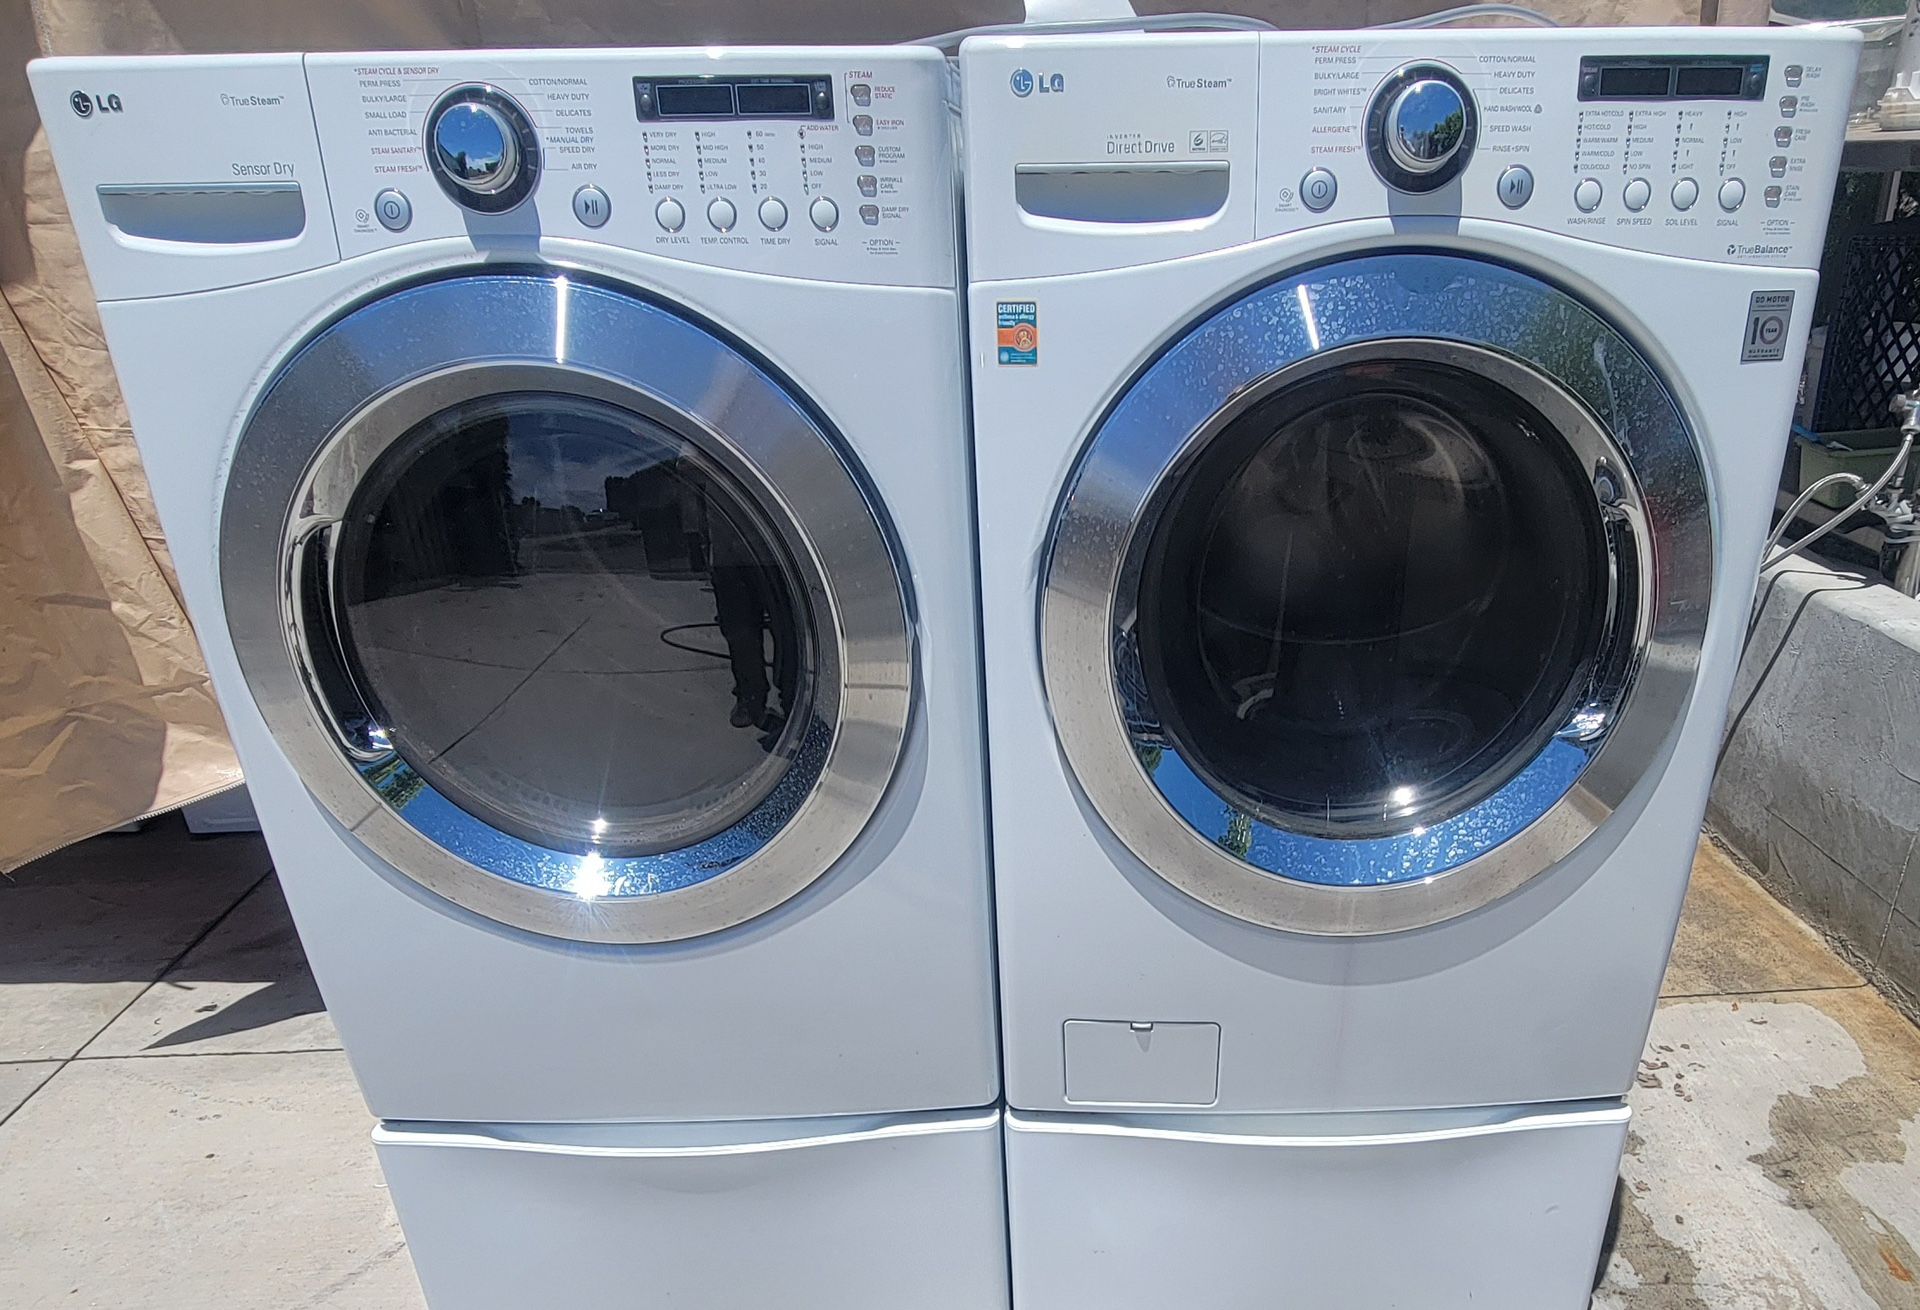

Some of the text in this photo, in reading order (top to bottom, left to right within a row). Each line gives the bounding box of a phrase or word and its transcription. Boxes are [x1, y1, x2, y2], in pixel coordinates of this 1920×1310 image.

[1314, 72, 1359, 80] BULKY/LARGE
[1039, 73, 1064, 93] LG
[96, 94, 124, 112] LG
[1106, 141, 1175, 154] Direct Drive
[232, 162, 294, 177] Sensor Dry
[1665, 218, 1698, 226] SOIL LEVEL
[998, 304, 1035, 313] CERTIFIED
